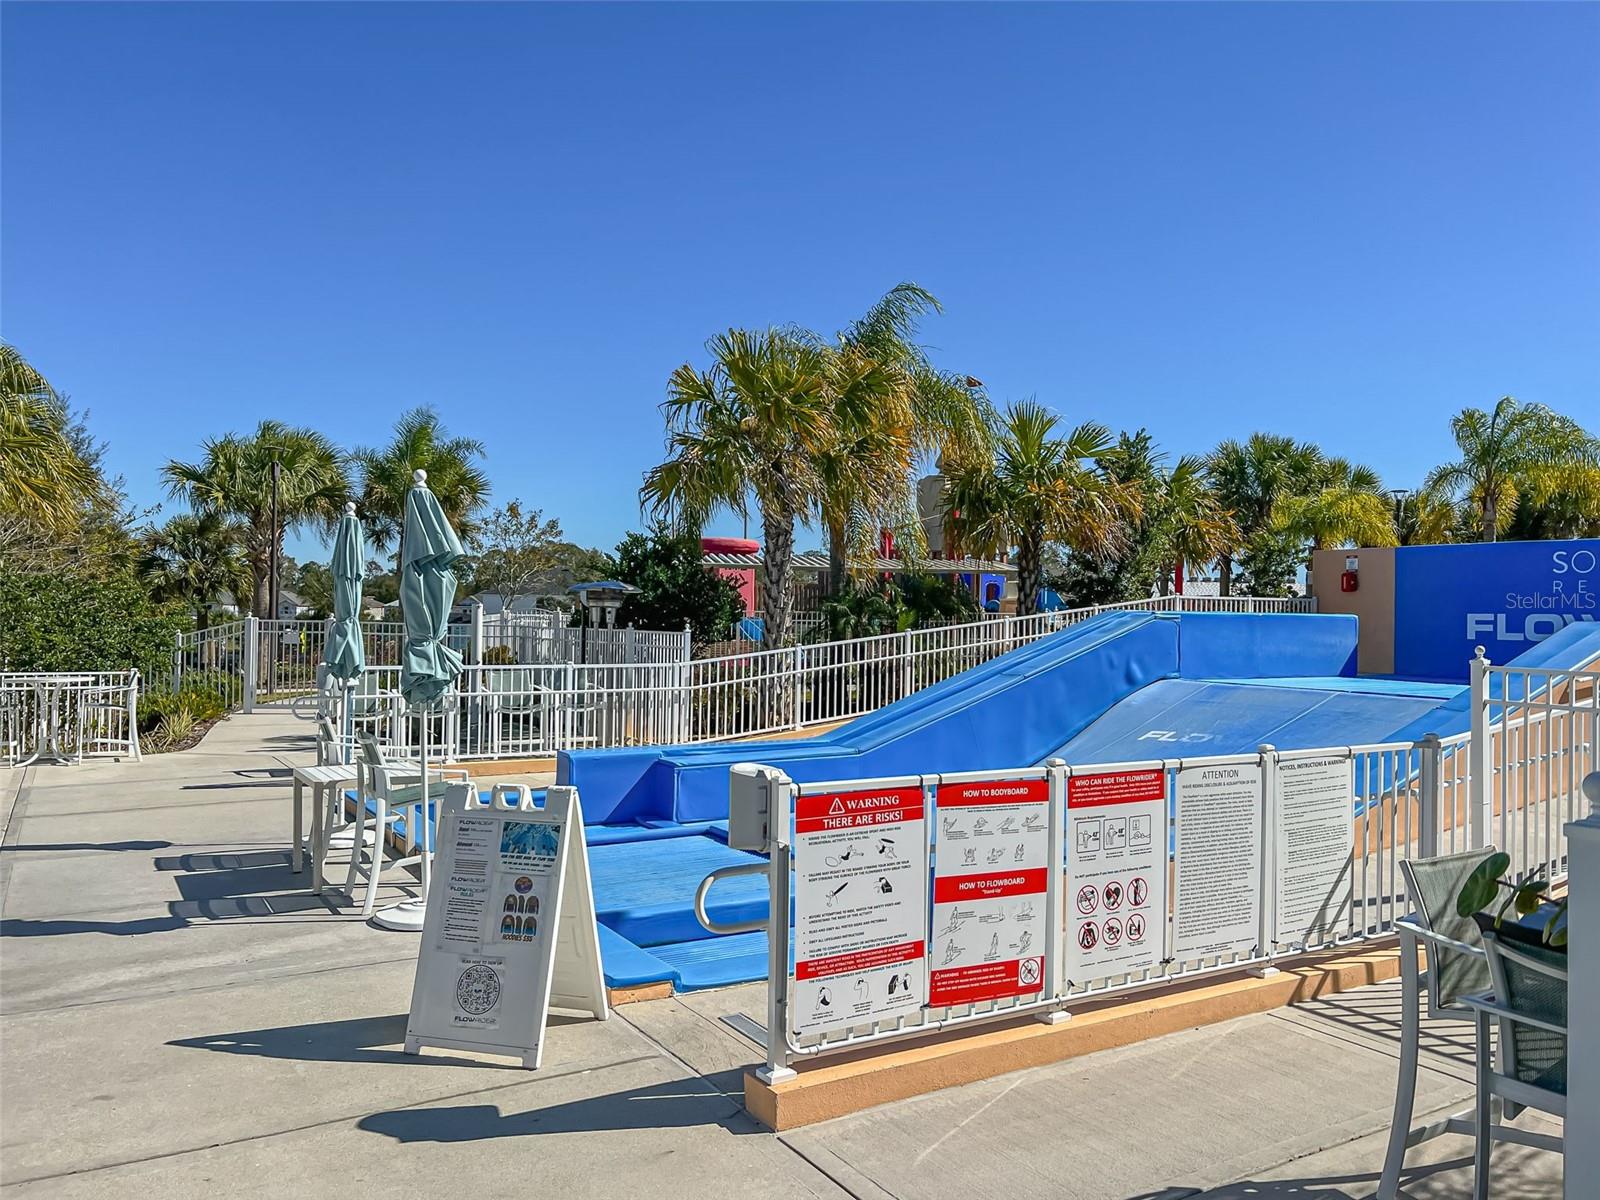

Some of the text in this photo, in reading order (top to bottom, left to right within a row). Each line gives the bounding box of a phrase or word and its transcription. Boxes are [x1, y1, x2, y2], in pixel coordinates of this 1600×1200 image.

[1466, 613, 1600, 642] FLO
[1202, 769, 1239, 780] ATTENTION
[1075, 778, 1090, 786] WHO
[1090, 778, 1102, 786] CAN
[963, 787, 1028, 798] HOW TO BODYBOARD
[846, 795, 900, 810] WARNING
[823, 810, 903, 829] THERE ARE RISKS!
[959, 882, 976, 890] HOW
[987, 877, 1025, 887] FLOWBOARD
